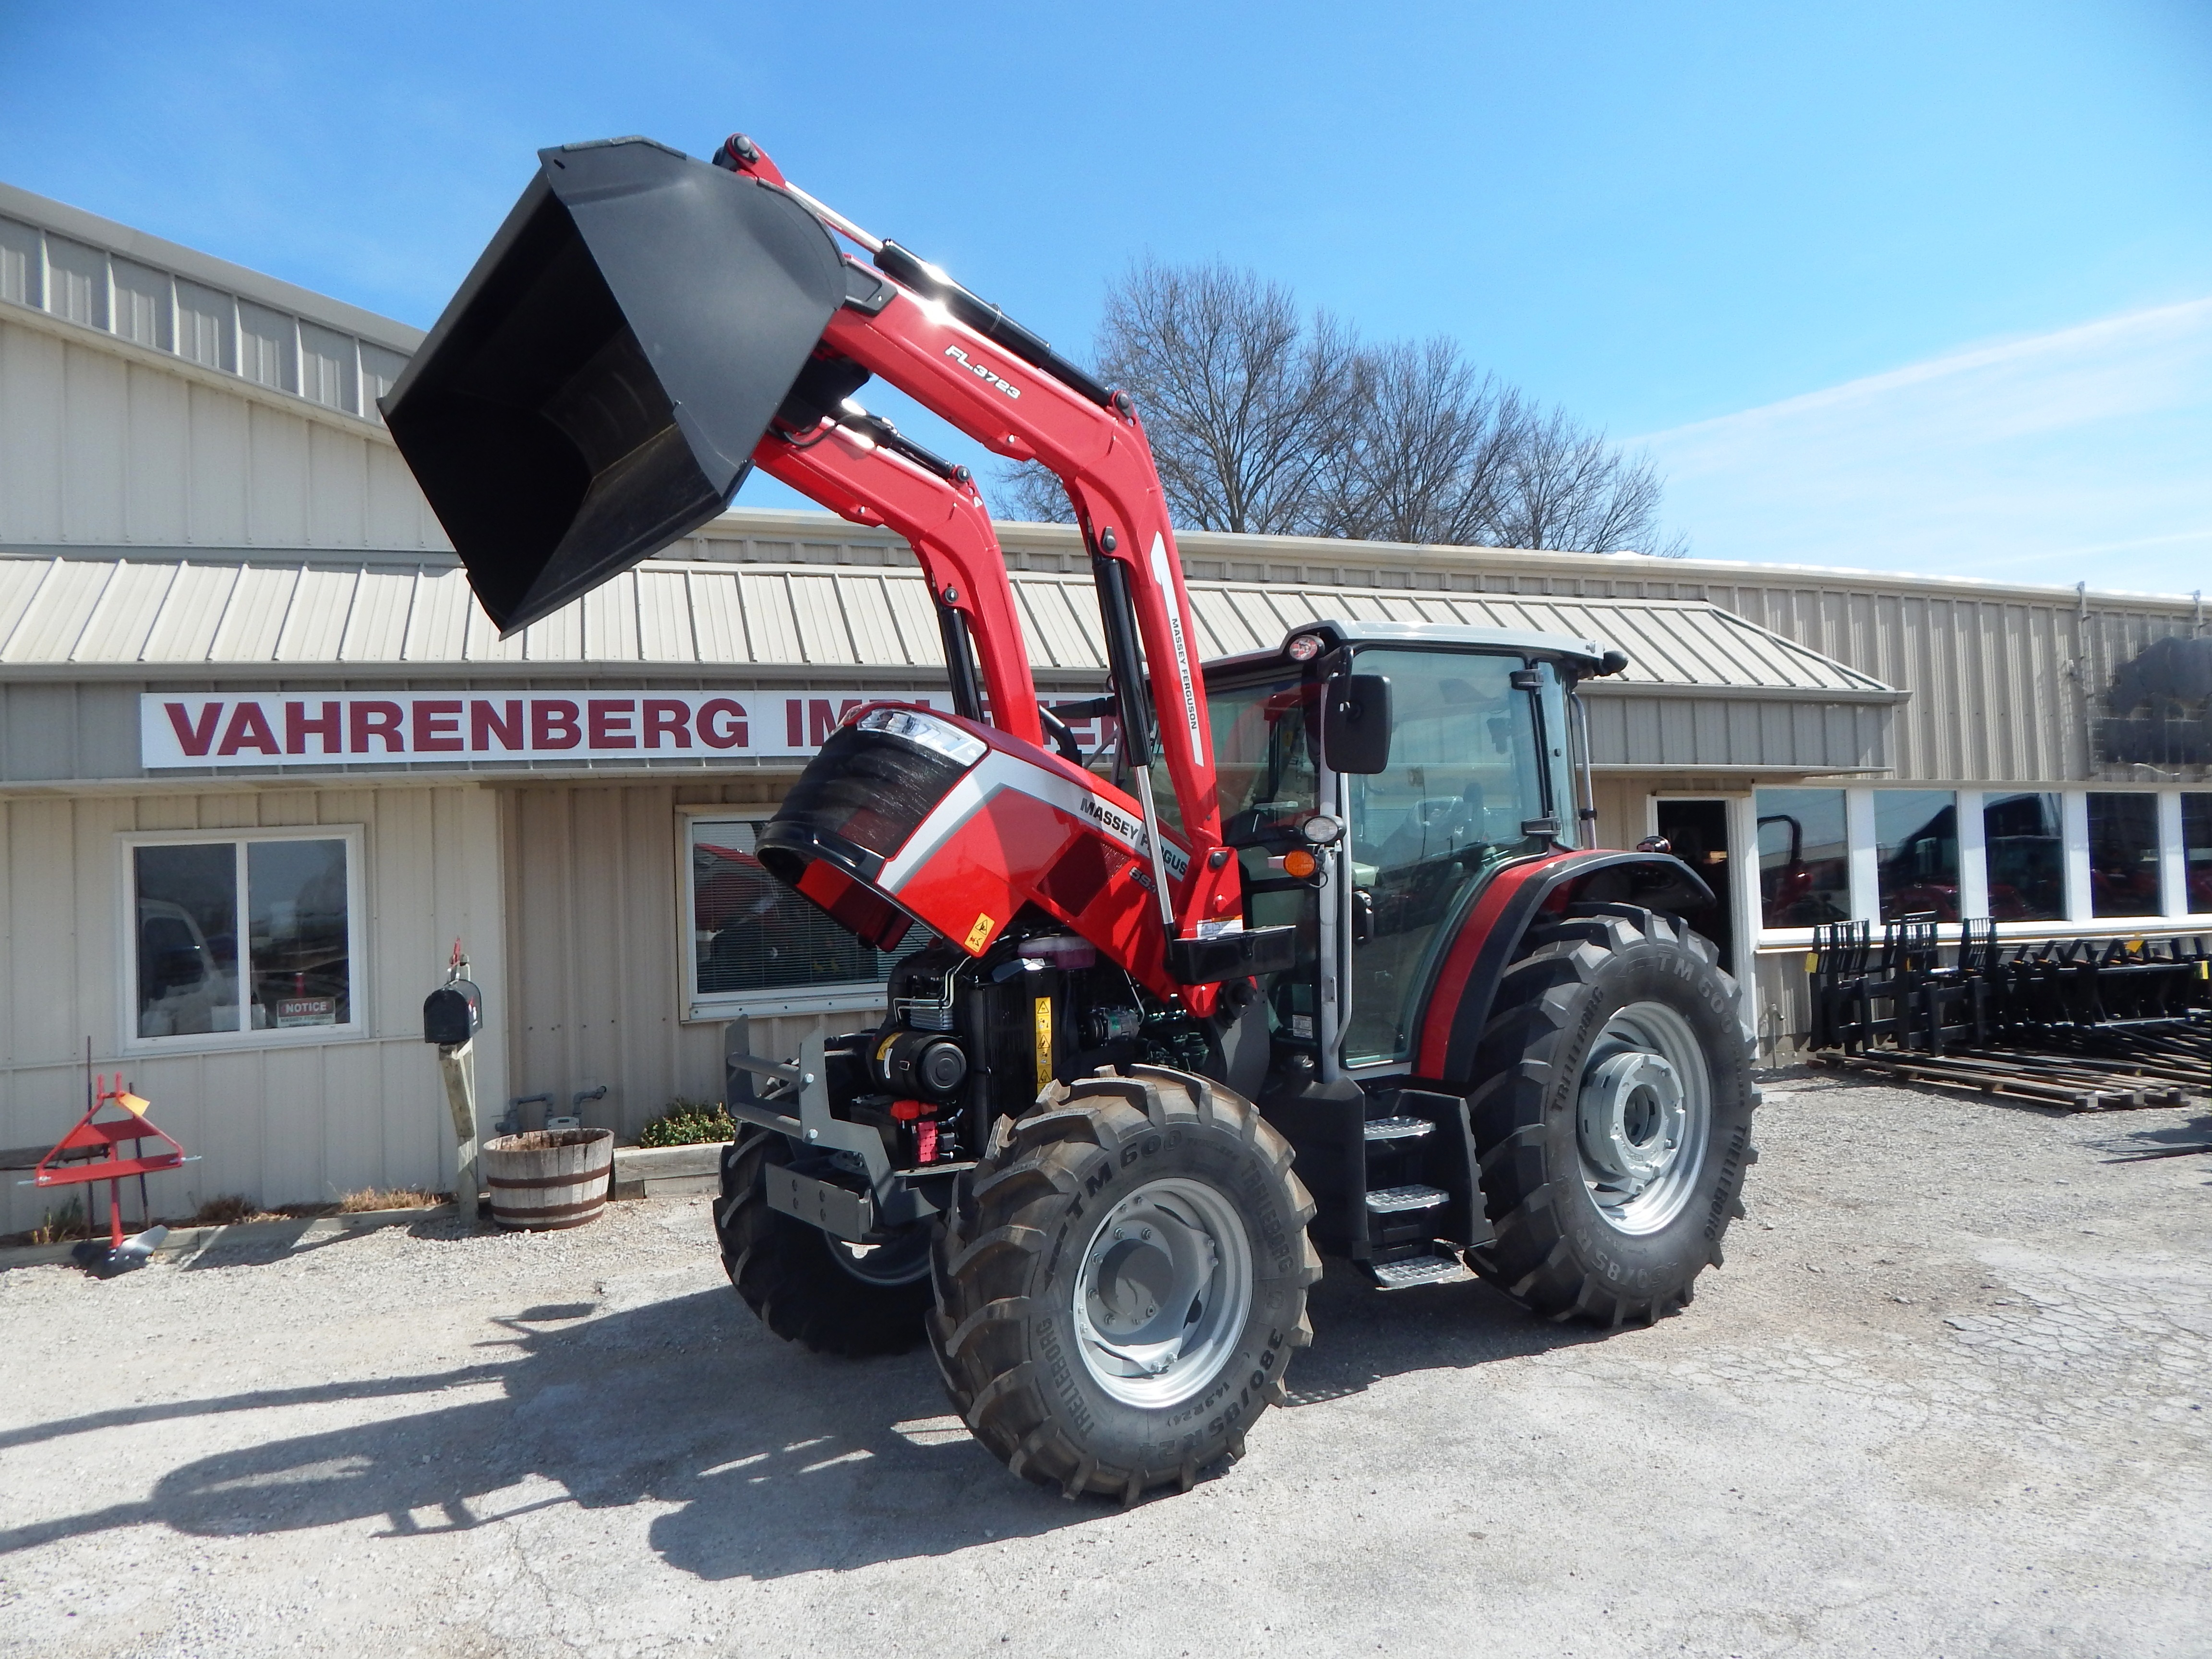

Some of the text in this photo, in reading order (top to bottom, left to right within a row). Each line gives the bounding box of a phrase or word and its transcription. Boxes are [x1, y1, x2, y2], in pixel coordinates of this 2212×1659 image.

[945, 345, 1022, 399] FL.3723
[1172, 618, 1197, 730] MASSEY FERGUSON
[164, 698, 749, 756] VAHRENBERG
[1080, 797, 1188, 876] MASSEY FGUS
[286, 1001, 327, 1013] NOTICE
[1241, 1158, 1294, 1273] TRELLEBORG
[1035, 1317, 1094, 1443] TRELLEBORG
